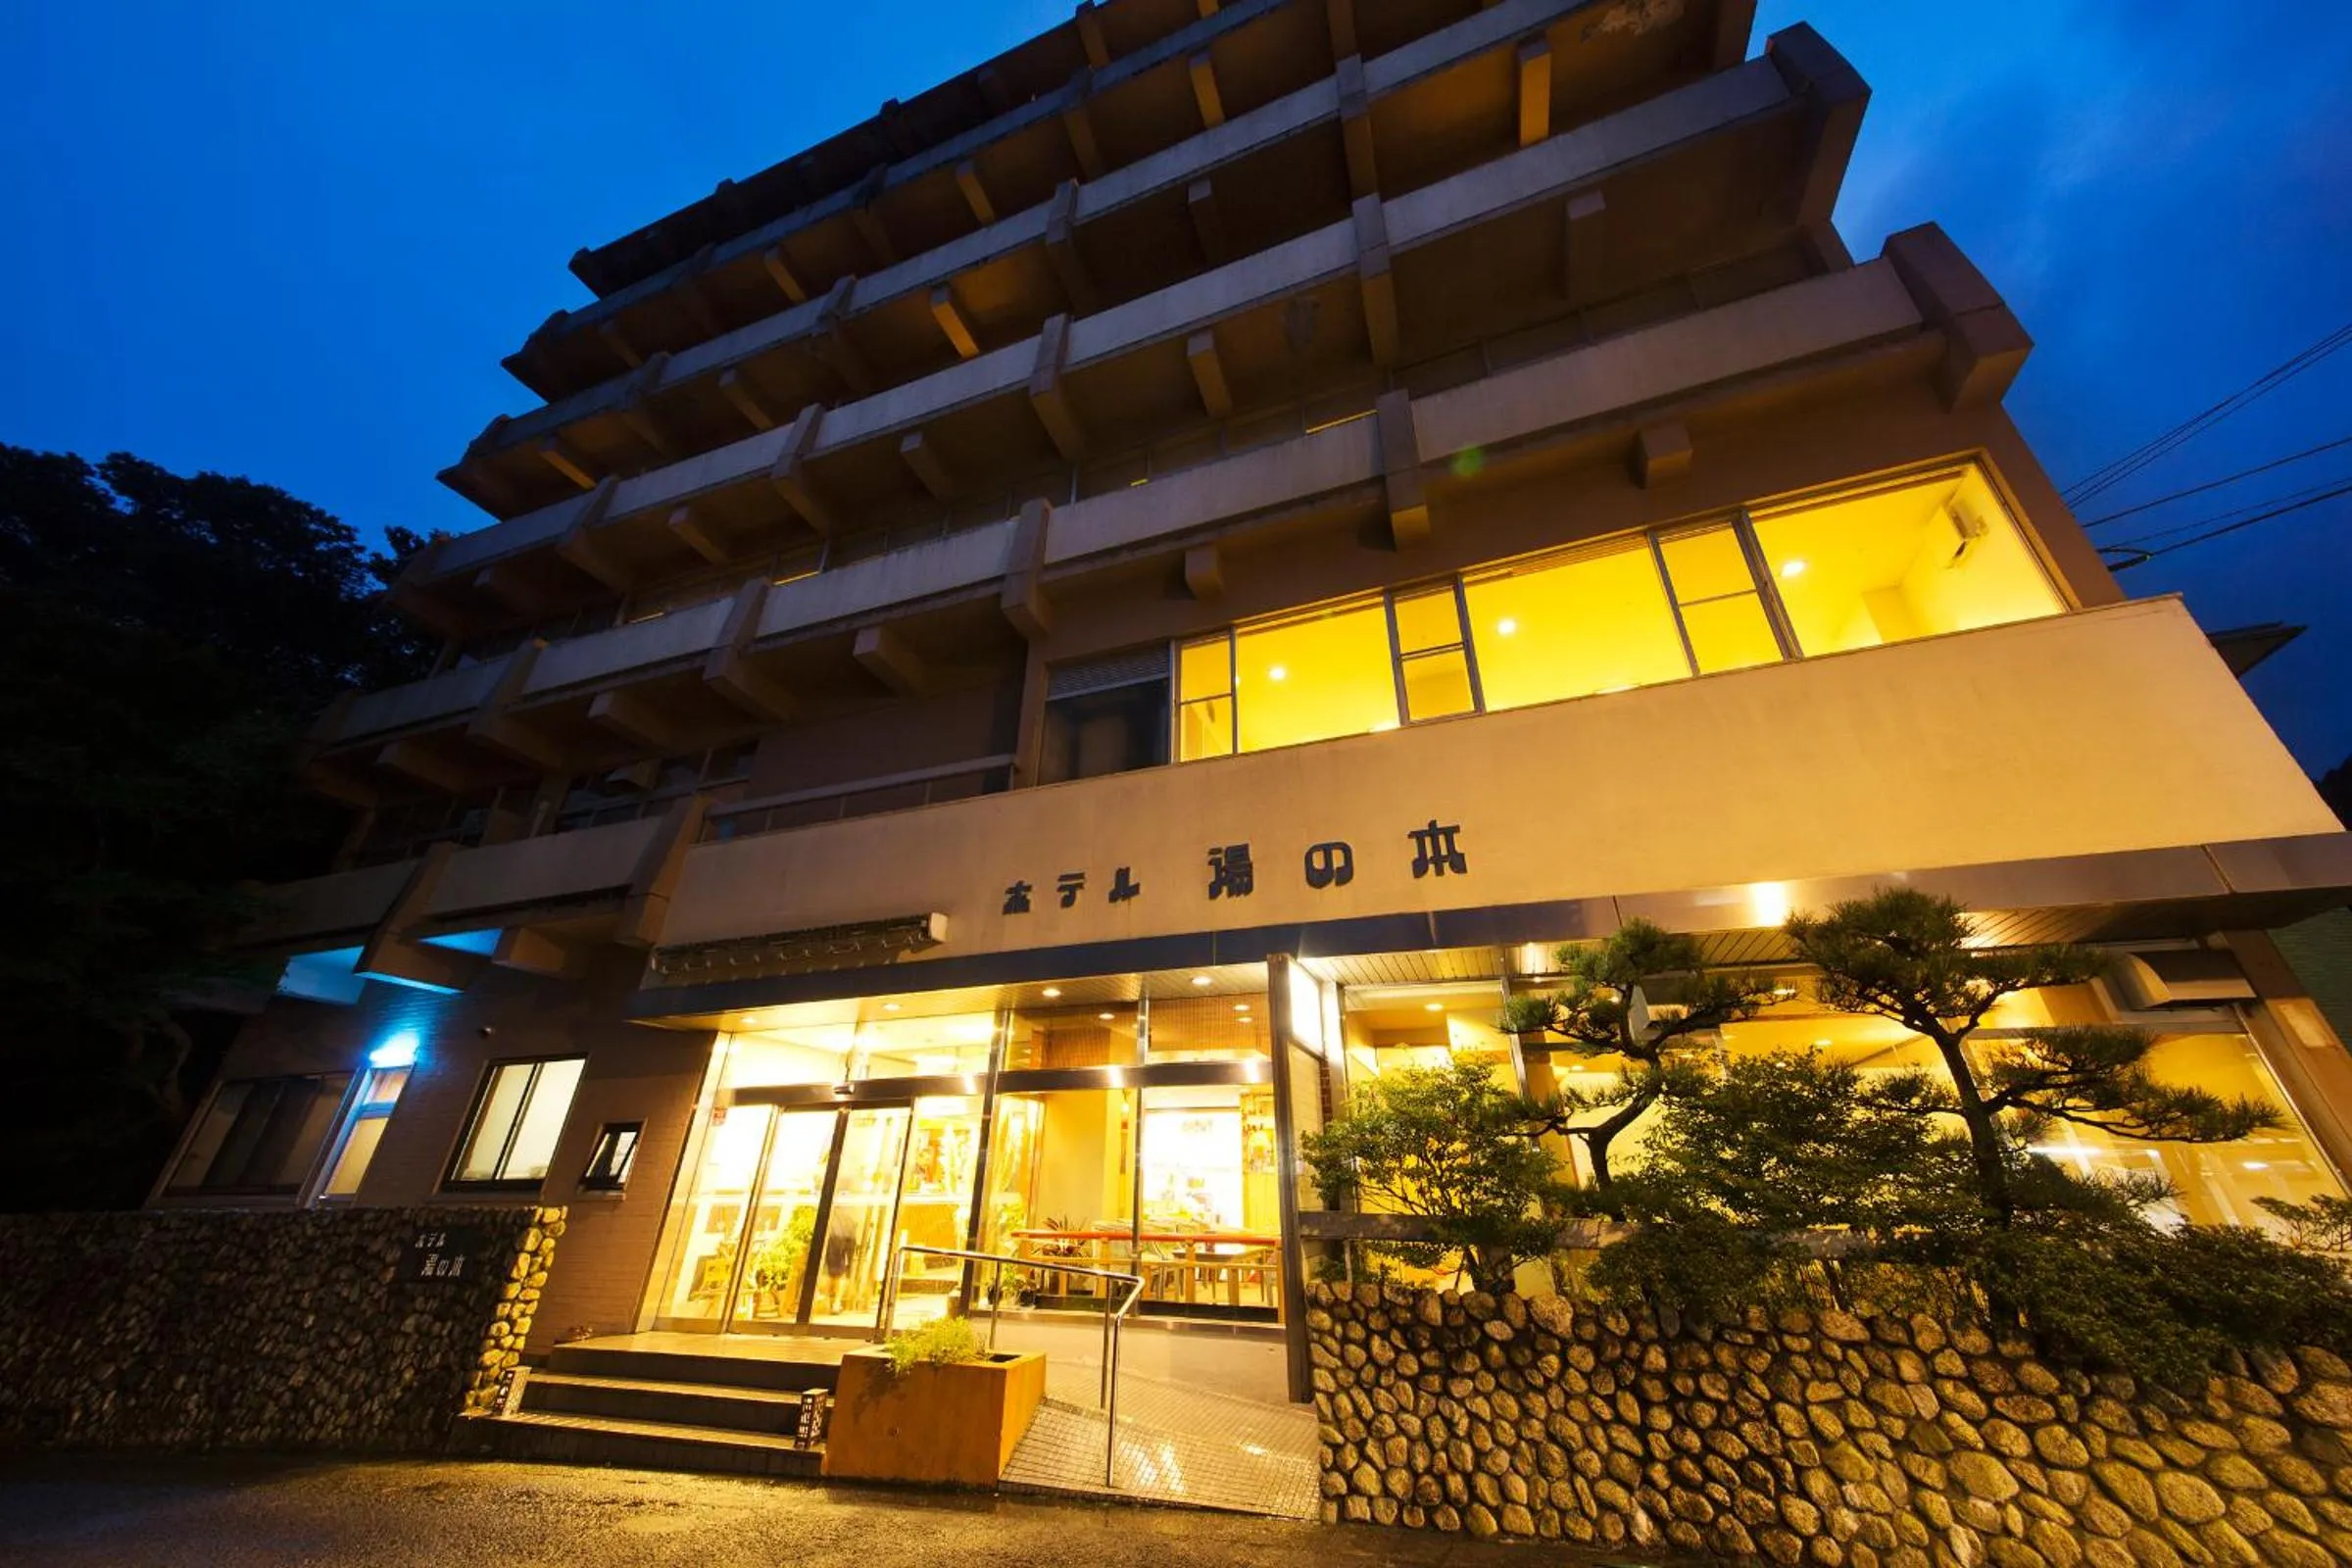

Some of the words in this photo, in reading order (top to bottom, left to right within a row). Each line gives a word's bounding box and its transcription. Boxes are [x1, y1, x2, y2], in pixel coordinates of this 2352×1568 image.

[1003, 866, 1140, 915] ホテル
[1207, 820, 1467, 901] 湯の本
